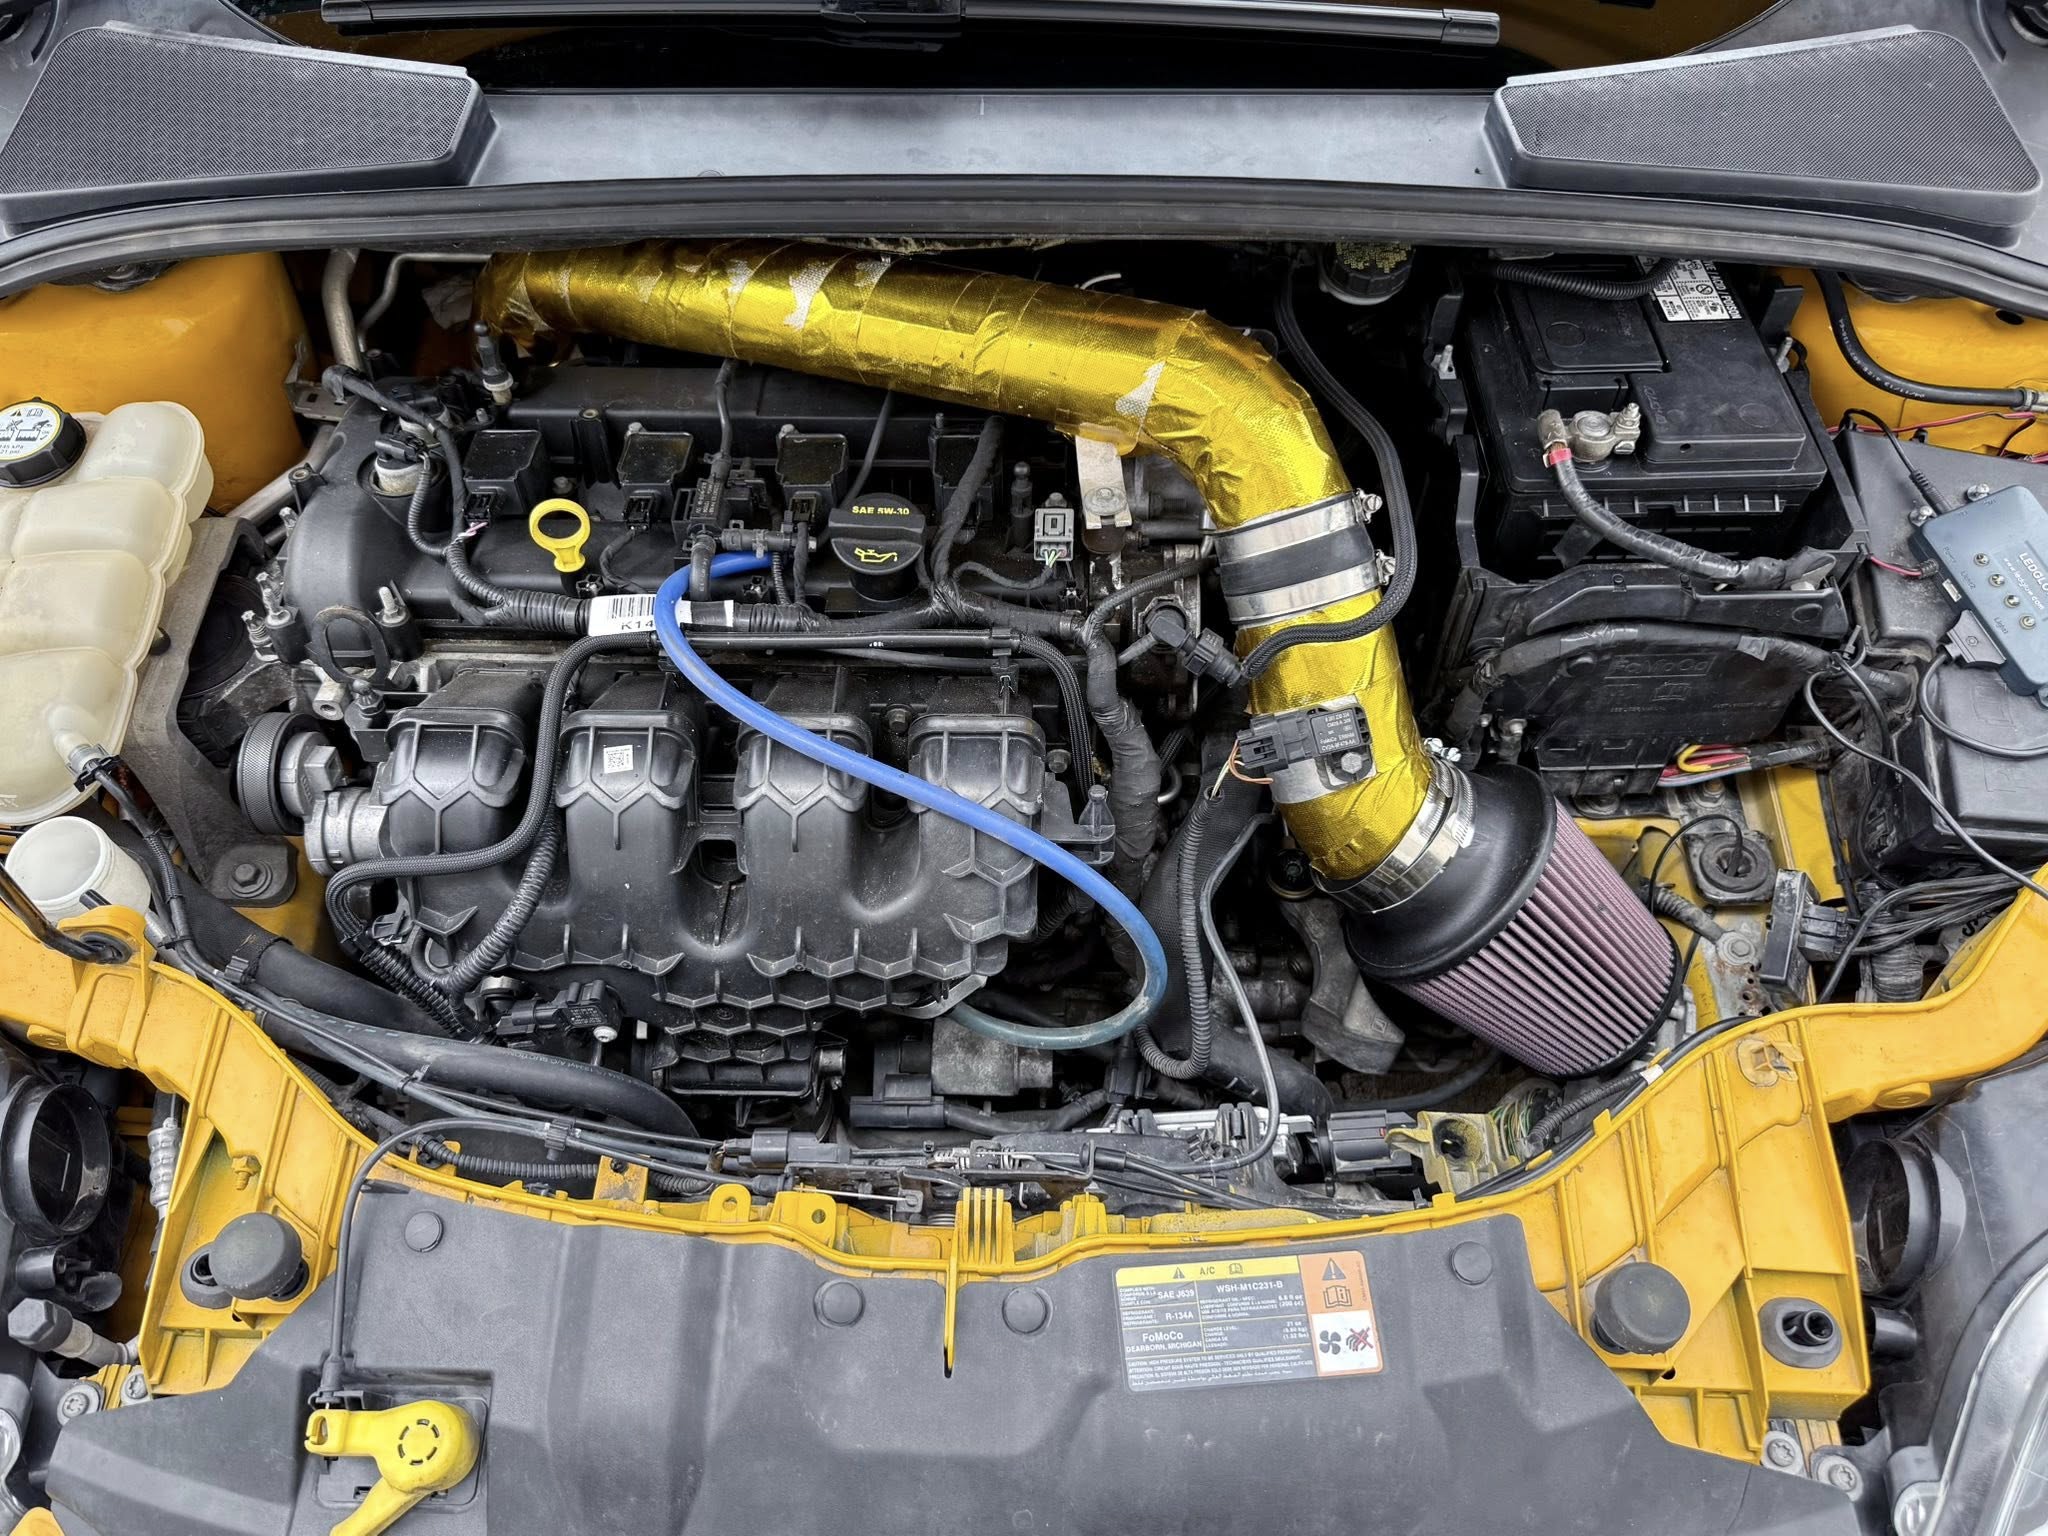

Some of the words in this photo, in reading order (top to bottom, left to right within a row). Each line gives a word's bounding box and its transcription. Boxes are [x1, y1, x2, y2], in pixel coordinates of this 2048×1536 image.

[1711, 275, 1727, 291] ACID
[1721, 295, 1742, 319] POISON
[852, 506, 875, 514] SAE
[877, 507, 910, 515] 5W-30
[2003, 557, 2045, 611] www.ledglow.com
[1610, 658, 1709, 675] FoMoCo
[1200, 1266, 1216, 1276] A/C
[1216, 1280, 1283, 1293] WSH-M1C231-B
[1157, 1291, 1175, 1299] SAE
[1176, 1289, 1195, 1298] J639
[1165, 1311, 1194, 1321] R-134A
[1142, 1331, 1184, 1342] FoMoCo
[1126, 1344, 1167, 1353] DEARBORN,
[1168, 1340, 1203, 1350] MICHIGAN
